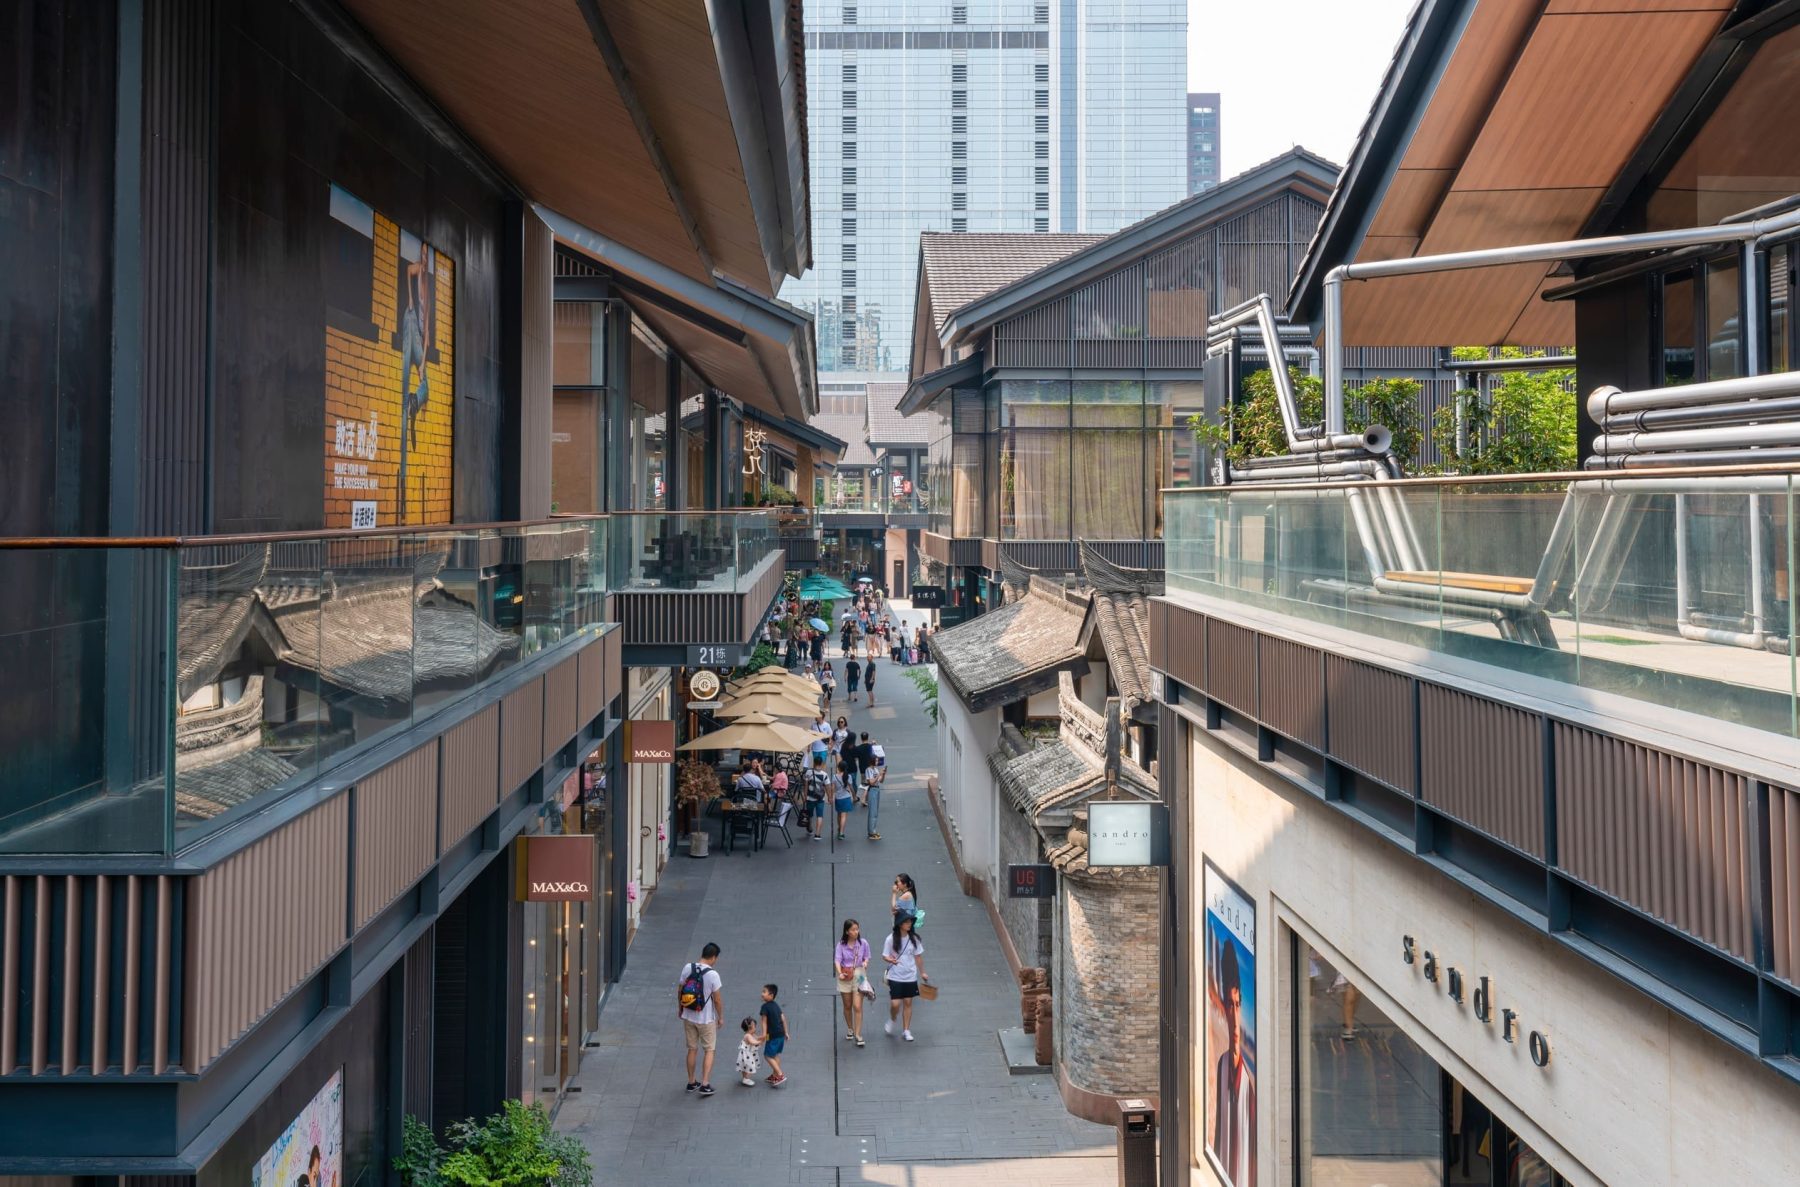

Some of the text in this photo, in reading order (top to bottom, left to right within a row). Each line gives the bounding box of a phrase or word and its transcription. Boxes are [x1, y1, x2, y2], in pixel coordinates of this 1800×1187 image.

[1092, 830, 1148, 838] sandro
[1213, 893, 1255, 946] sandro
[1403, 935, 1549, 1067] sandro
